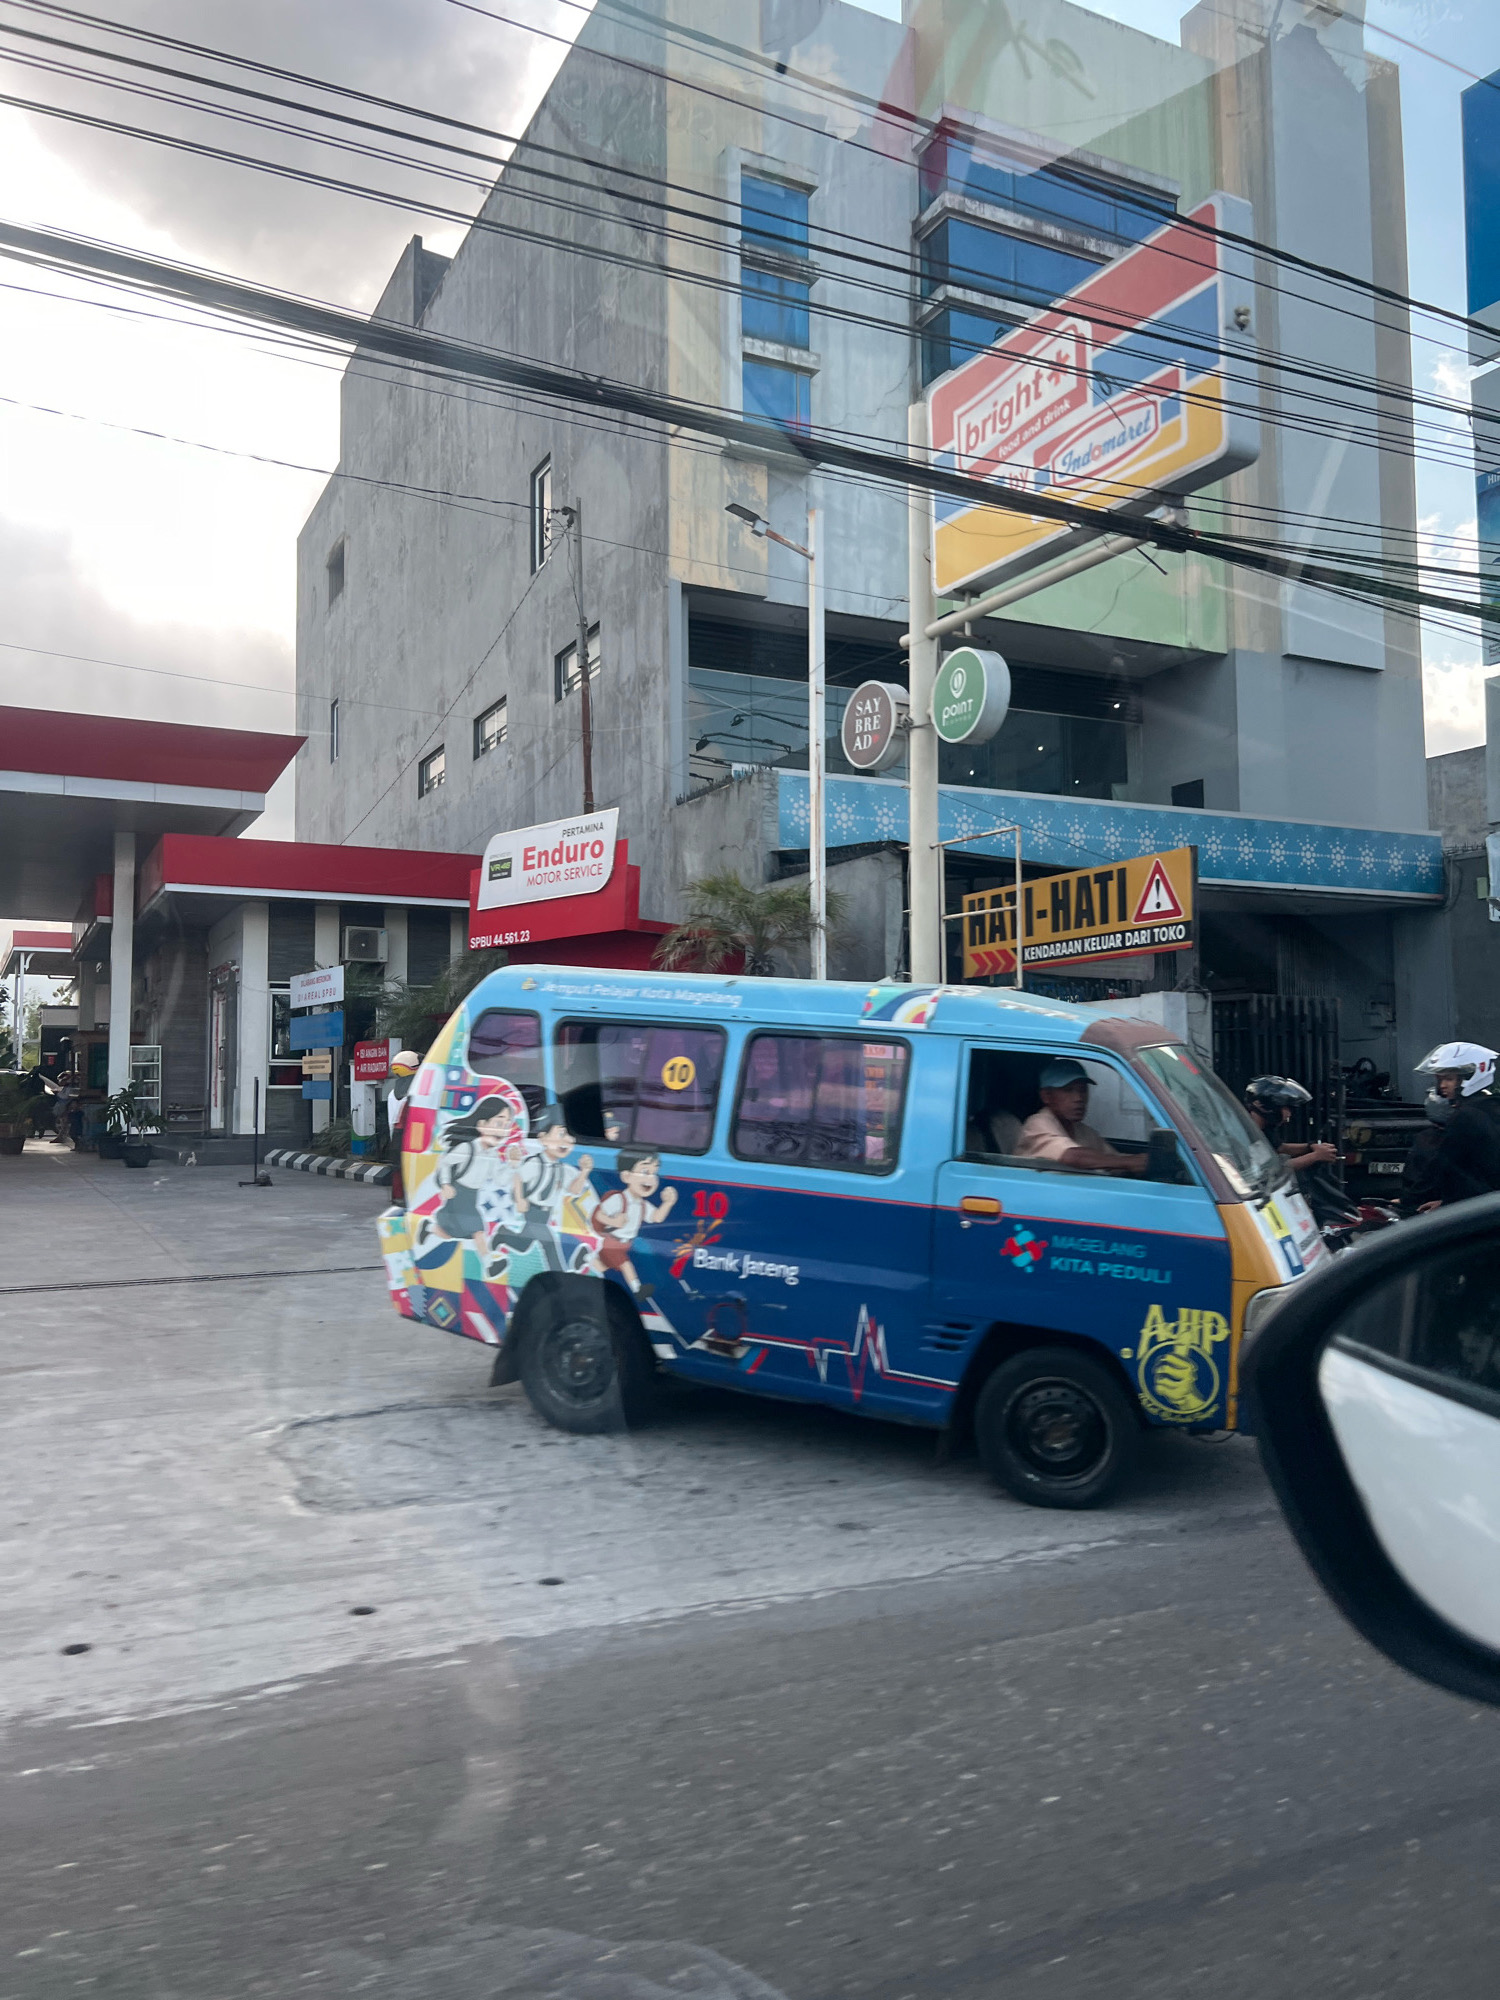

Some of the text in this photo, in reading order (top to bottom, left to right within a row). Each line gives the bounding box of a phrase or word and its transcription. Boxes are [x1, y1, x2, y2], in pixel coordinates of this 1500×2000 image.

[966, 369, 1043, 454] bright
[999, 400, 1071, 459] food and drink
[1060, 409, 1151, 476] Indomaret
[855, 697, 882, 717] SAY
[855, 714, 882, 734] BRE
[852, 734, 873, 752] AD
[561, 821, 605, 838] PERTAMINA
[522, 839, 605, 871] Enduro
[526, 863, 604, 887] MOTOR SERVICE
[968, 867, 1128, 947] HATI-HATI
[470, 934, 492, 949] SPBU
[1024, 924, 1186, 962] KENDARAAN KELUAR DARI TOKO
[304, 990, 321, 1001] AREAL
[322, 987, 337, 998] SPBU
[378, 1047, 387, 1057] BAN
[667, 1062, 690, 1084] 10
[692, 1190, 729, 1219] 10
[1050, 1234, 1147, 1259] MAGELANG
[693, 1248, 799, 1286] Bank Jateng
[1050, 1256, 1172, 1285] KITA PEDULI
